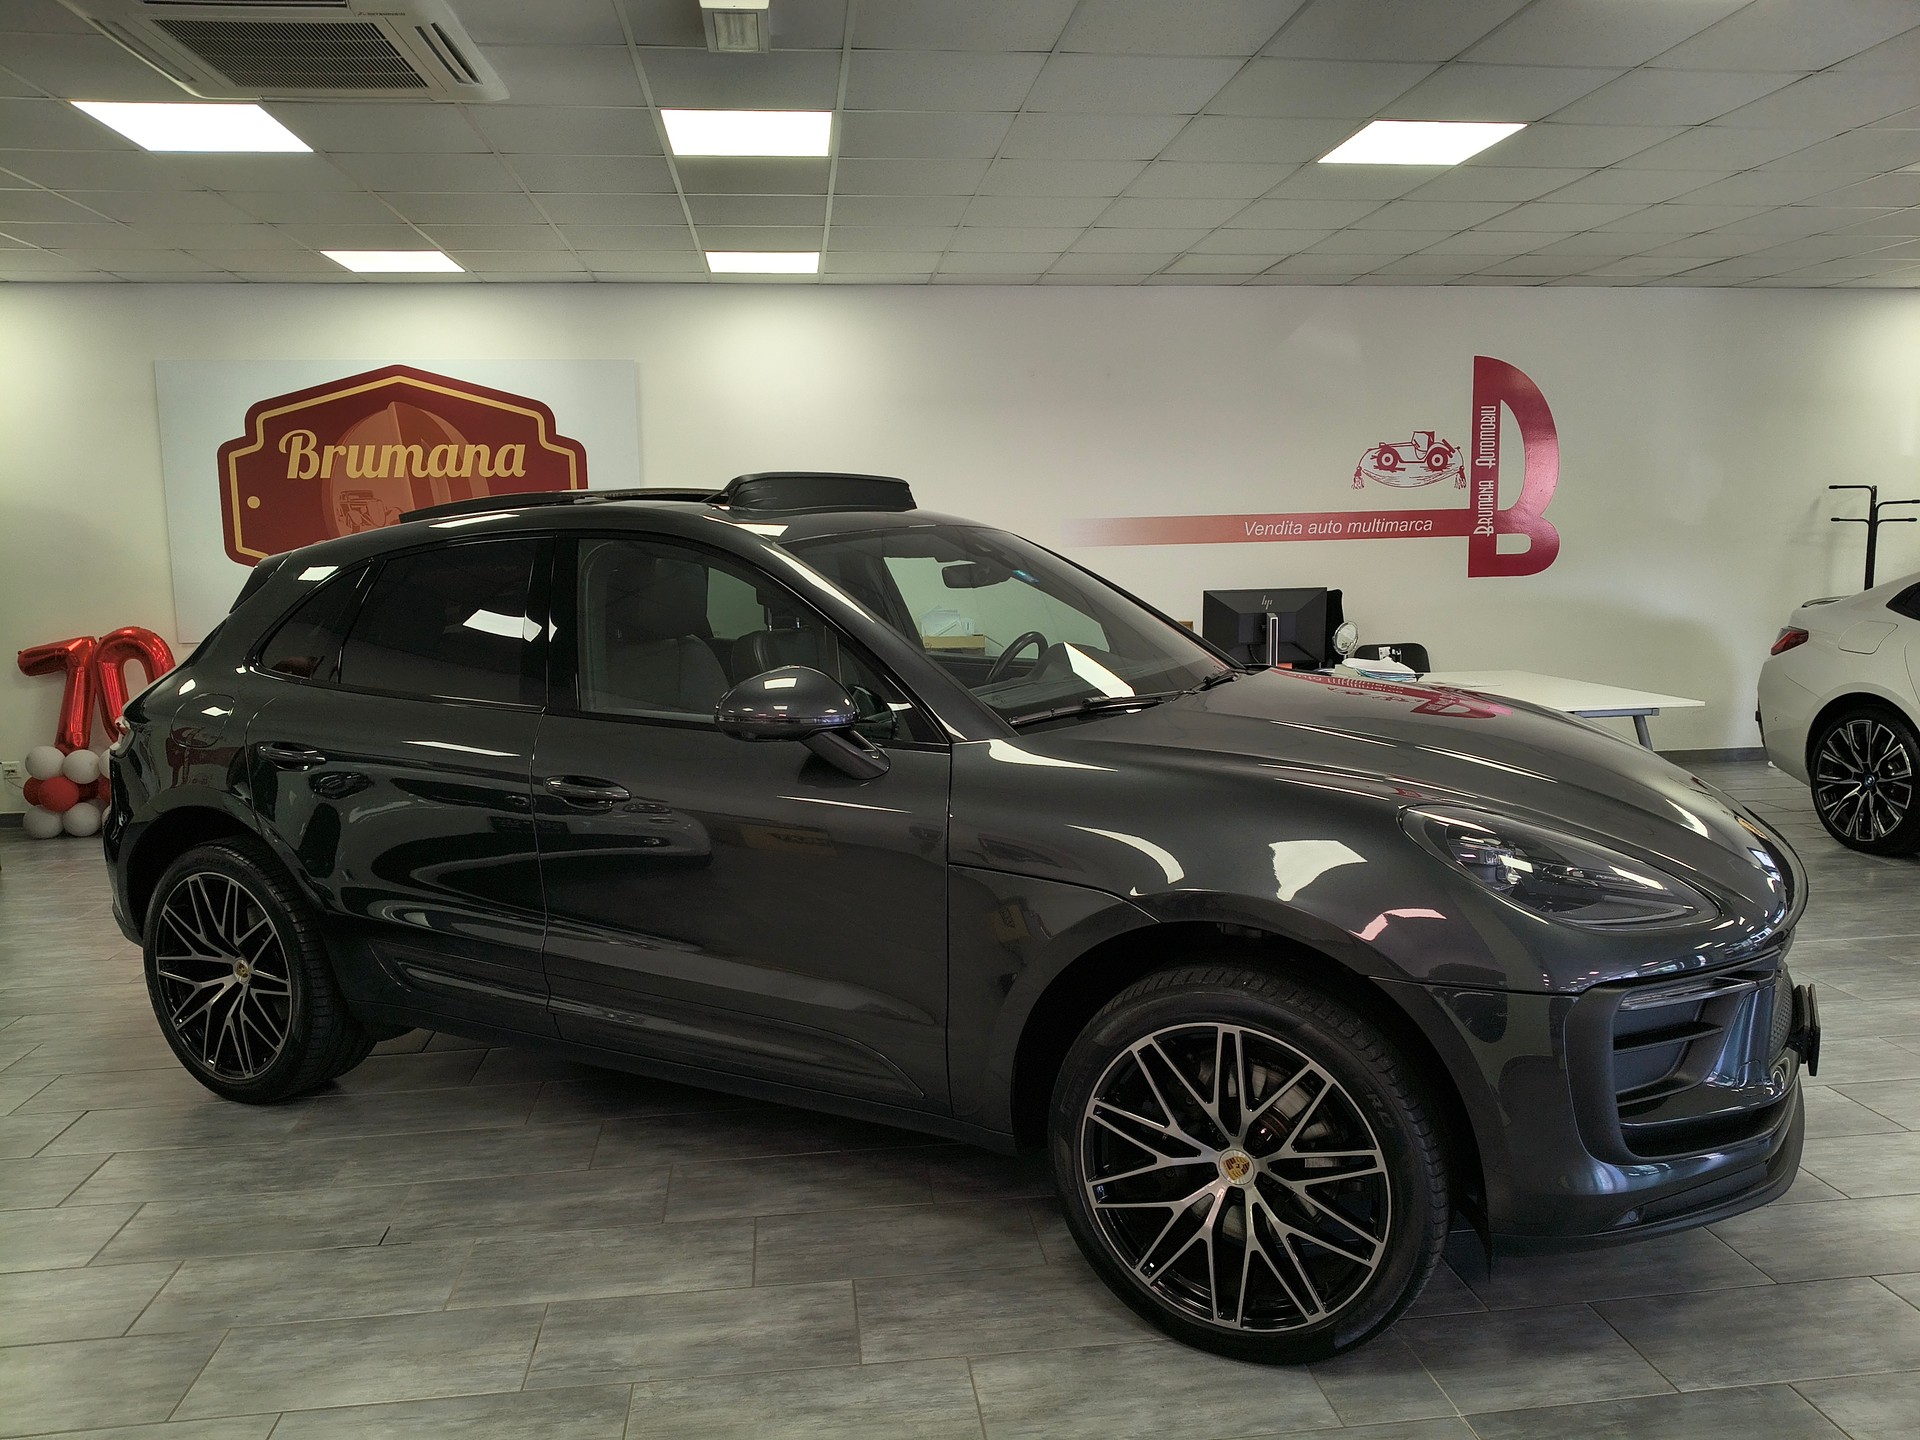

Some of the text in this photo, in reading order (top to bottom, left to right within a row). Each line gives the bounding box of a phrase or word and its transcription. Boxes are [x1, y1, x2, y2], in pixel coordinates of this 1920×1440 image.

[279, 429, 526, 480] Brumana
[1244, 517, 1433, 536] Vendita auto multimarca
[1473, 480, 1494, 537] BRUMANA
